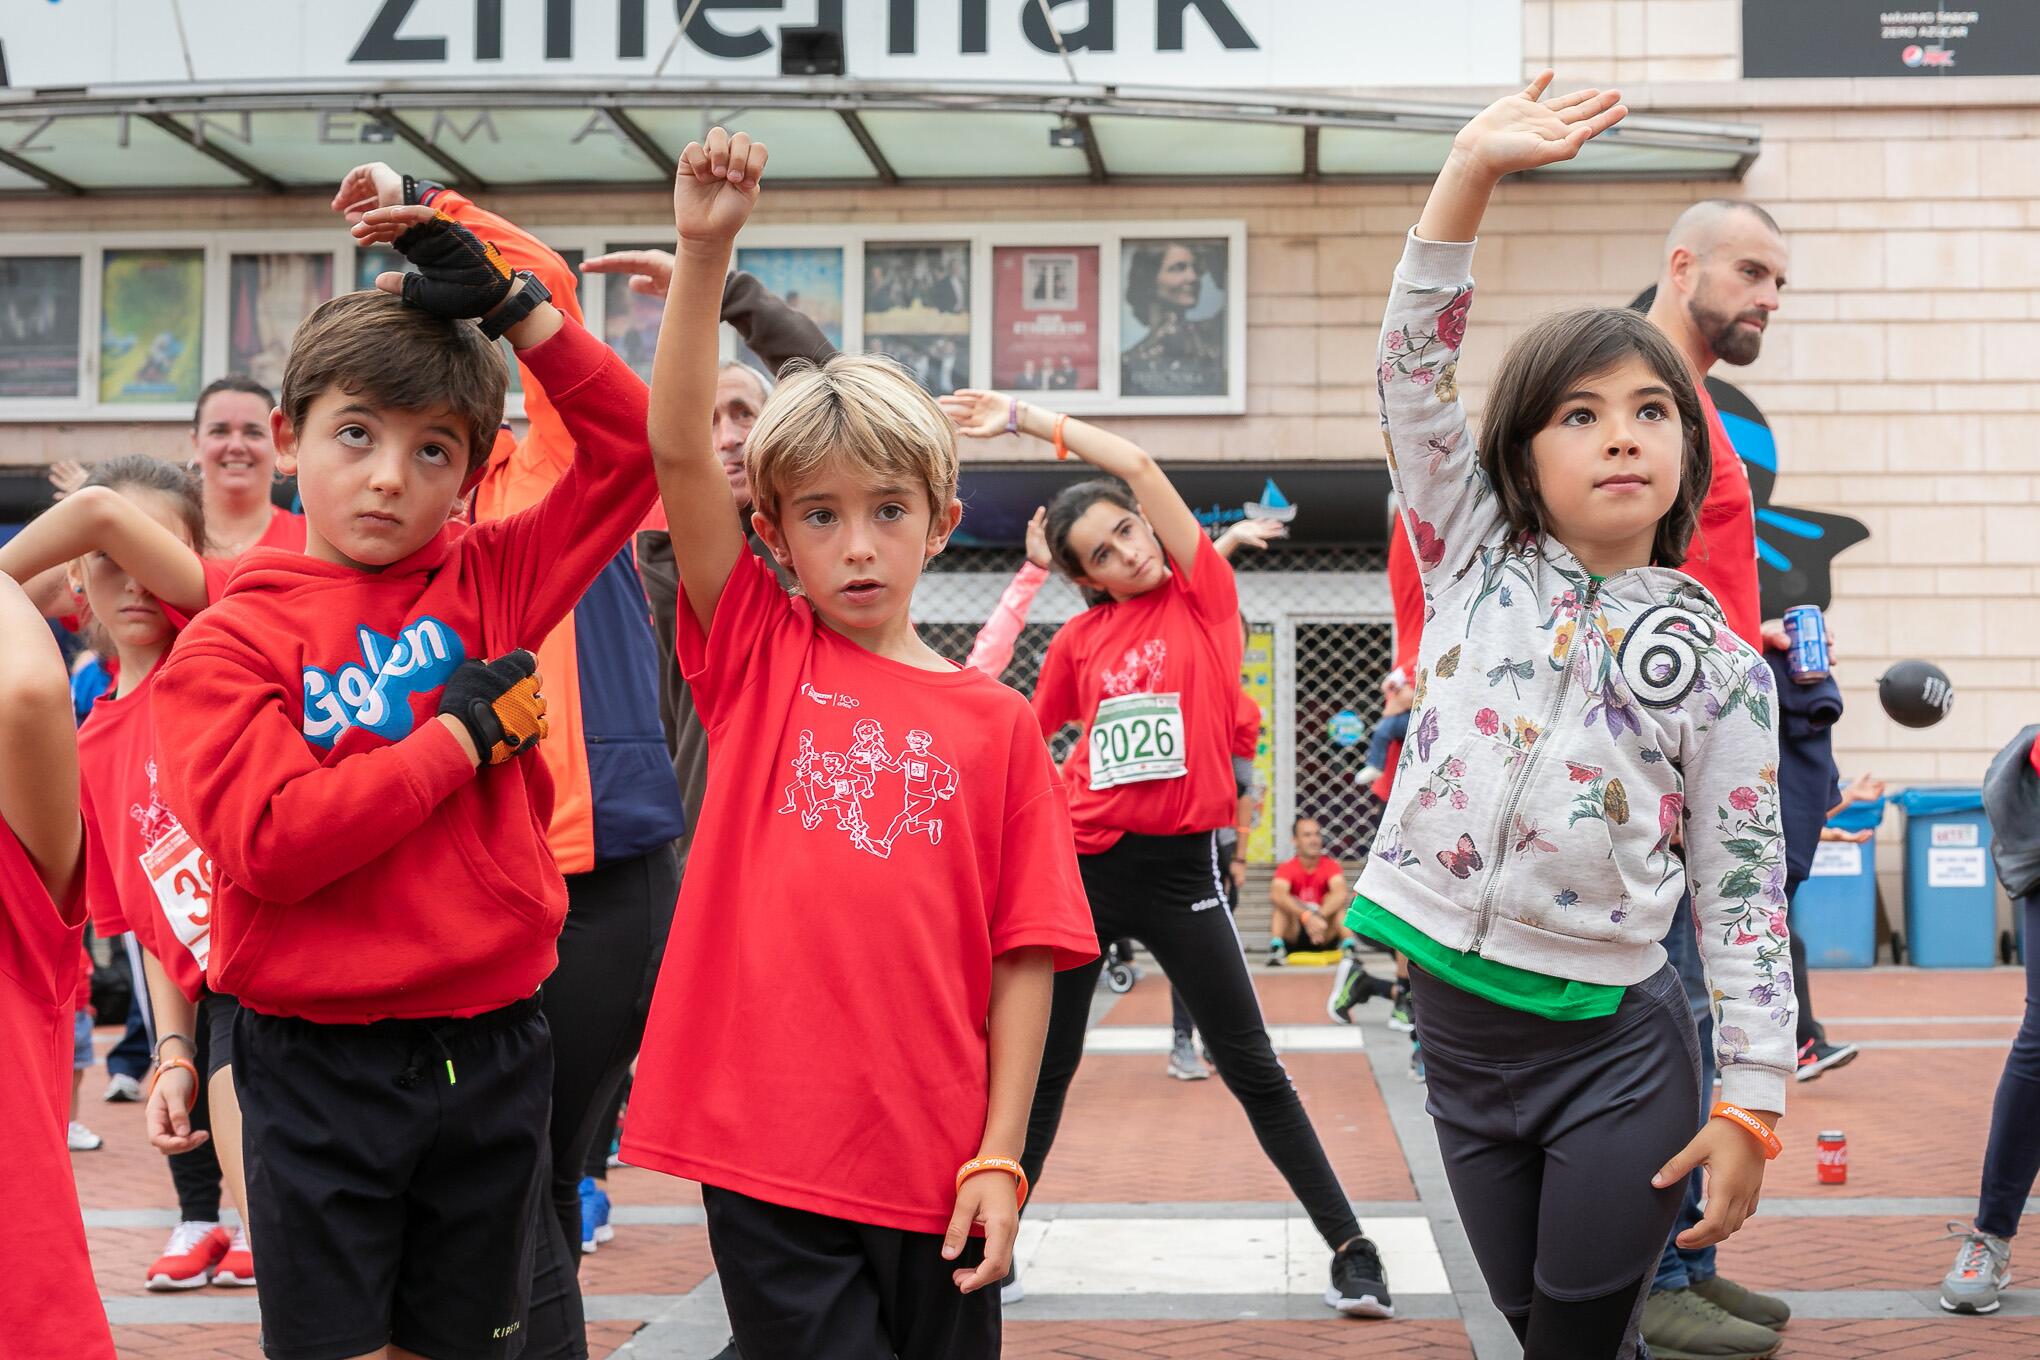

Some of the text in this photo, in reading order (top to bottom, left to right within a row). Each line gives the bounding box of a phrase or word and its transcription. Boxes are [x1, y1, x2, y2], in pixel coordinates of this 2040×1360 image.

[1617, 605, 1716, 709] 6
[838, 694, 860, 707] 100
[1094, 718, 1174, 766] 2026
[1727, 1106, 1761, 1129] CORREO
